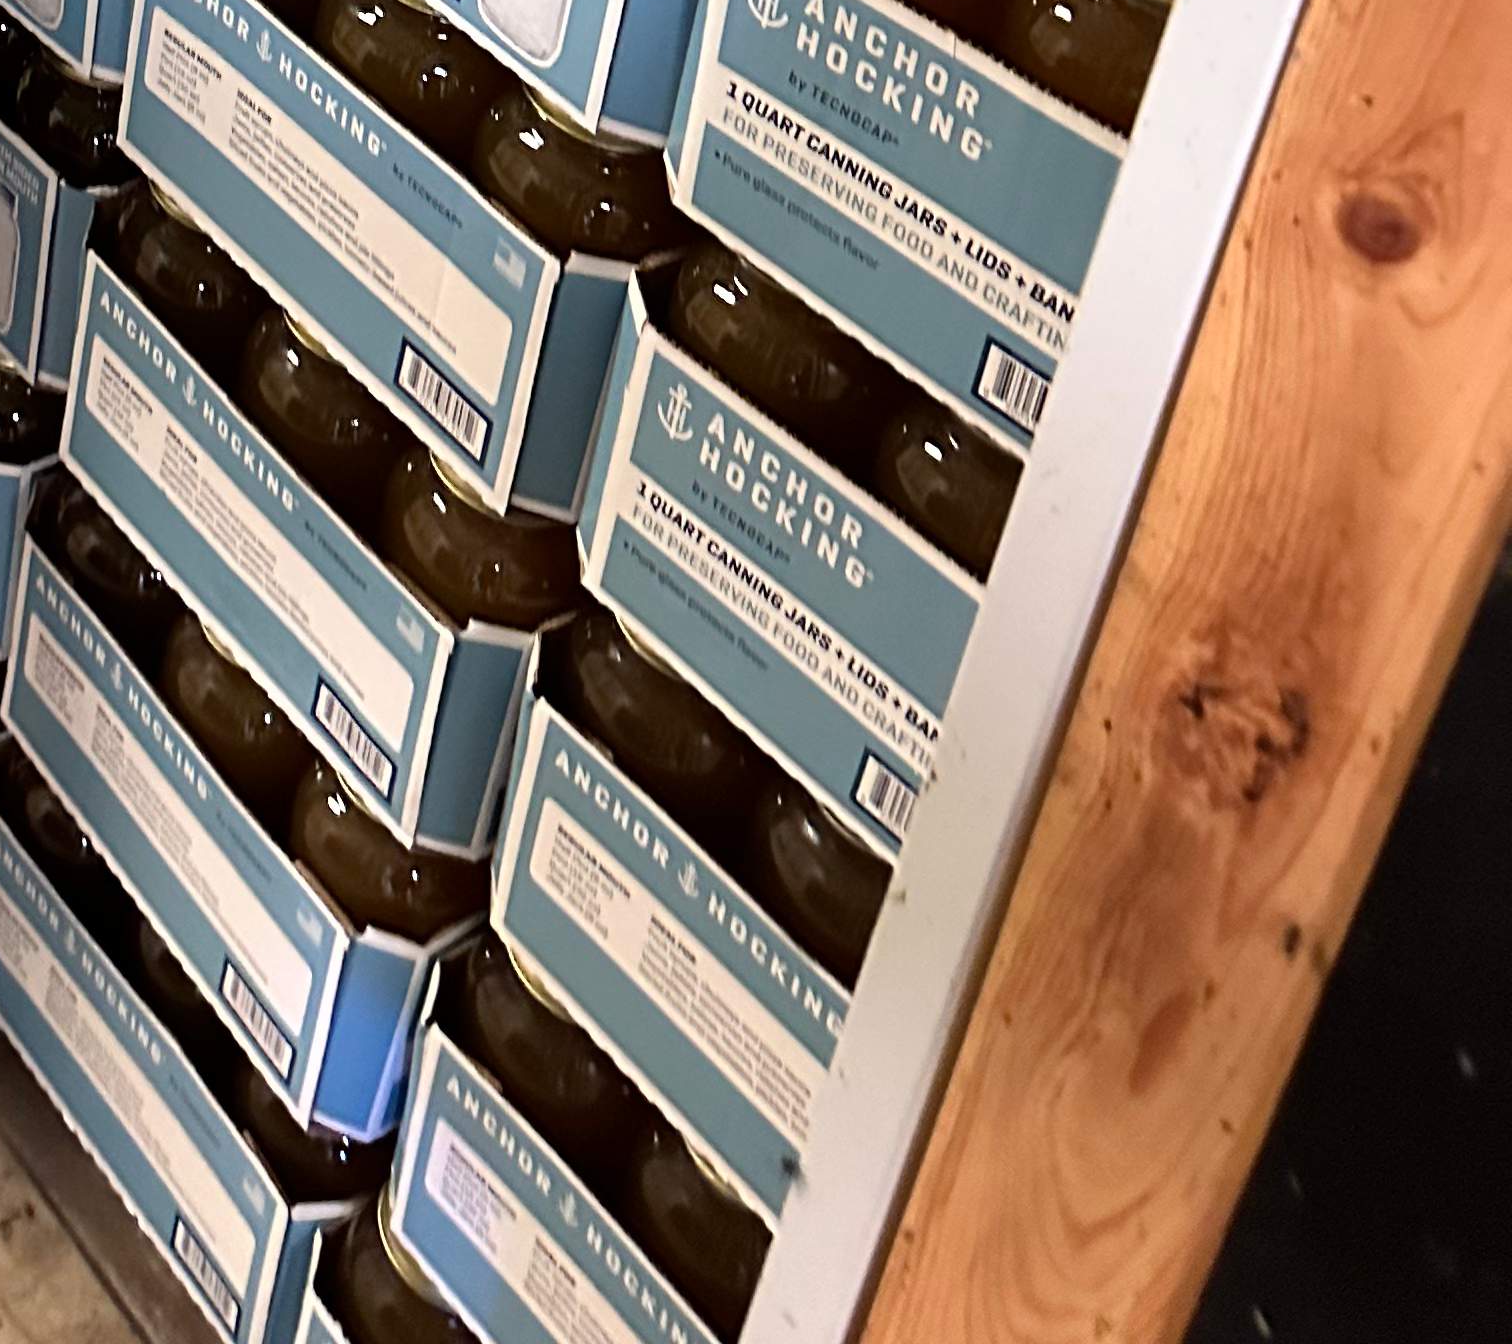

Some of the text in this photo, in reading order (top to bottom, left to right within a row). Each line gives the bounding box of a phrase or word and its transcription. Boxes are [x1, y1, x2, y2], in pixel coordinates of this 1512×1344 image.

[279, 52, 381, 157] HOCKING
[788, 69, 894, 145] by TECNOCAP
[796, 22, 983, 161] HOCKING
[722, 105, 1067, 352] FOR PRESERVING FOOD AND CRAFTIN
[726, 80, 737, 101] 1
[742, 91, 806, 141] QUART
[807, 133, 893, 199] CANNING
[894, 194, 948, 237] JARS
[965, 237, 1012, 280] LIDS
[1029, 280, 1076, 324] BAN
[100, 291, 177, 384] ANCHOR
[203, 399, 294, 512] HOCKING
[699, 437, 866, 589] HOCKING
[707, 412, 863, 549] ANCHOR
[37, 574, 106, 667] ANCHOR
[632, 502, 664, 539] FOR
[667, 530, 772, 631] PRESERVING
[773, 623, 820, 671] FOOD
[822, 670, 859, 705] AND
[637, 480, 646, 500] 1
[649, 494, 704, 544] QUART
[706, 537, 784, 610] CANNING
[785, 608, 832, 651] JARS
[847, 655, 890, 700] LIDS
[904, 704, 939, 741] BAN
[128, 684, 207, 800] HOCKING
[555, 748, 669, 870] ANCHOR
[446, 1074, 551, 1197] ANCHOR
[587, 1220, 687, 1344] HOCKIN
